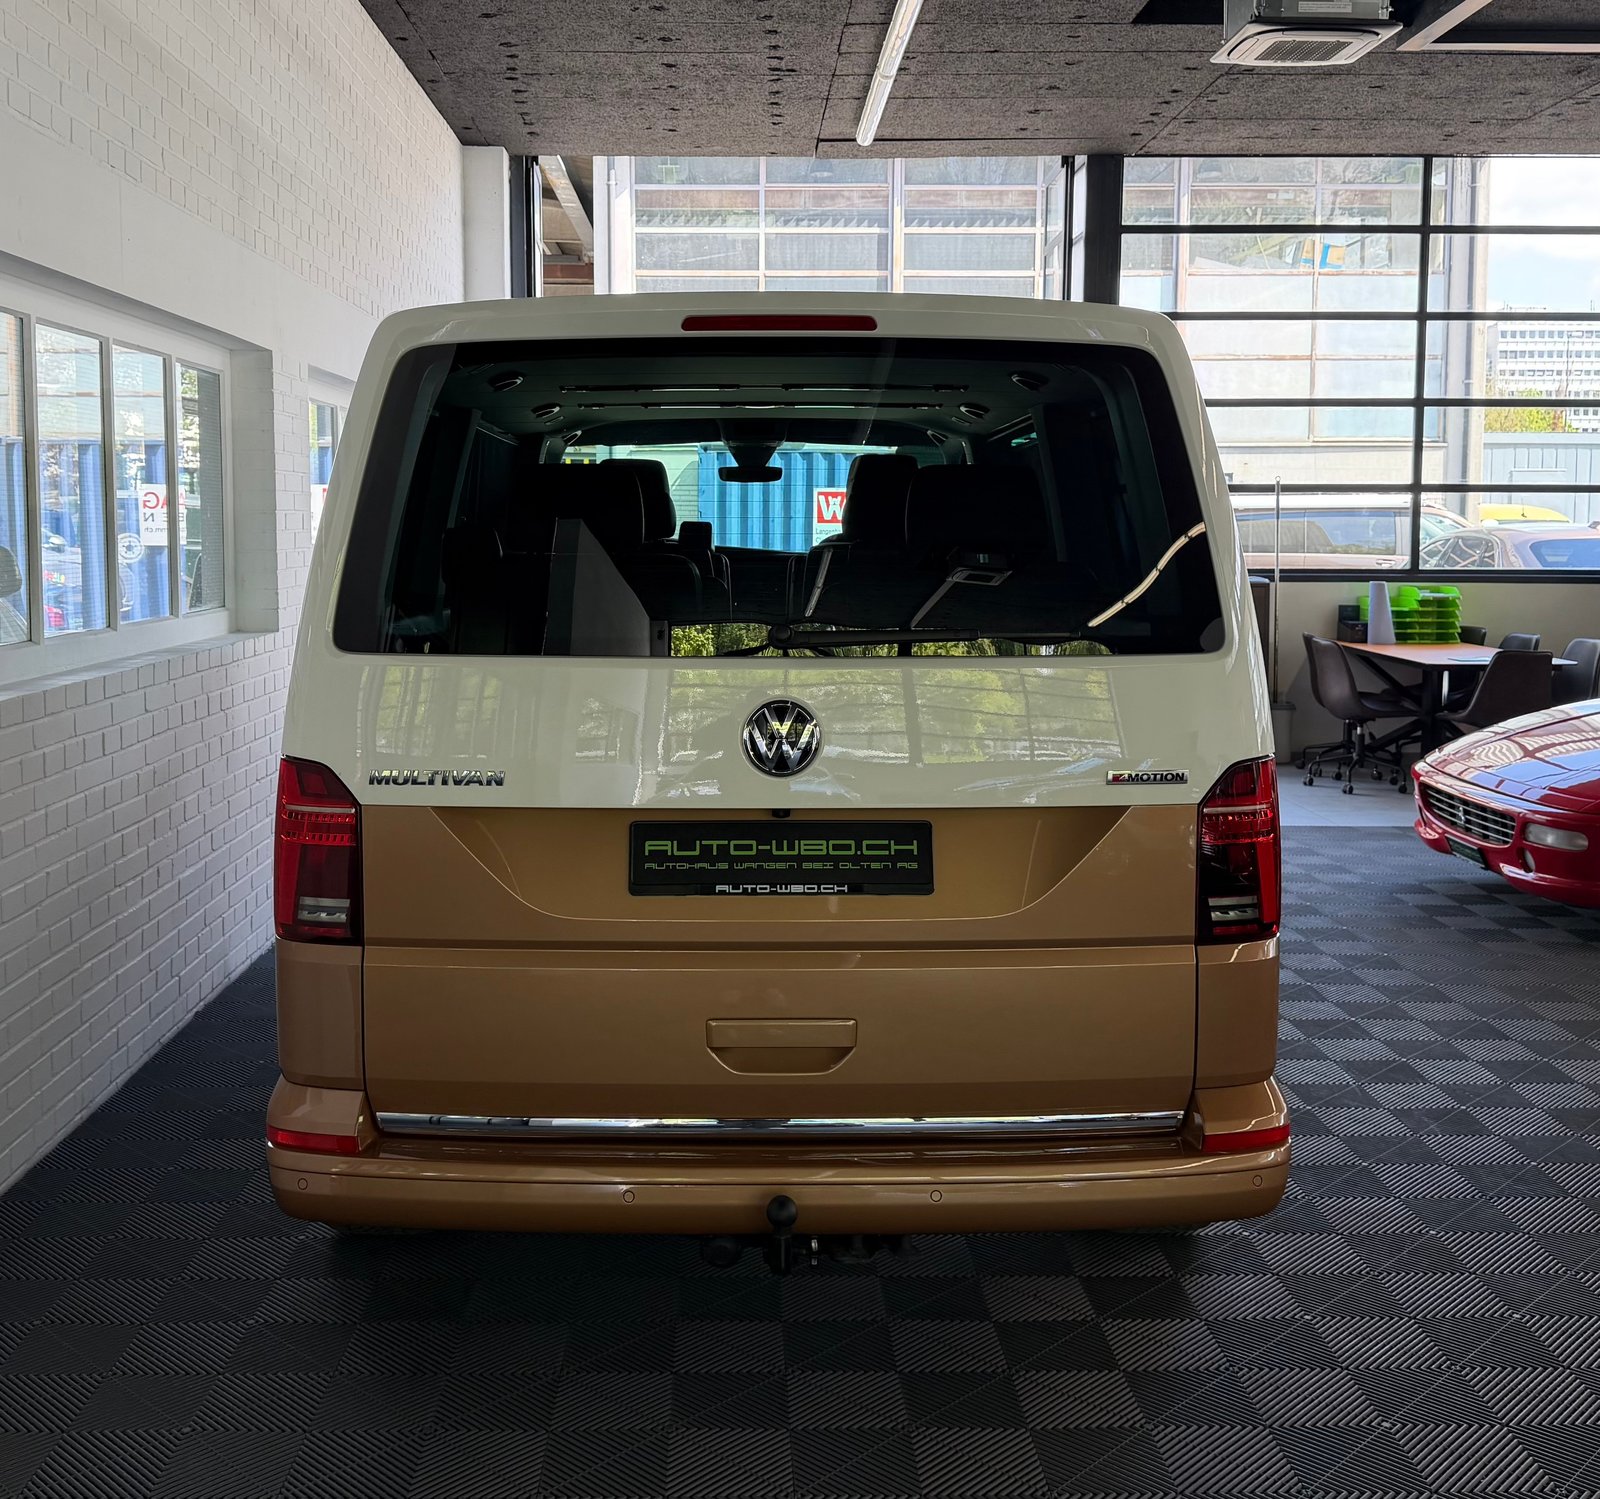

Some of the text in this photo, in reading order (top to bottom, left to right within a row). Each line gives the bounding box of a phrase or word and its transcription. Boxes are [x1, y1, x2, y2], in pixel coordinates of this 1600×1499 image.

[368, 770, 505, 786] MULTIVAN
[644, 840, 918, 856] AUTO-WBO.CH
[644, 862, 729, 870] AUTOHAUS
[715, 884, 848, 893] AUTO-WBO.CH
